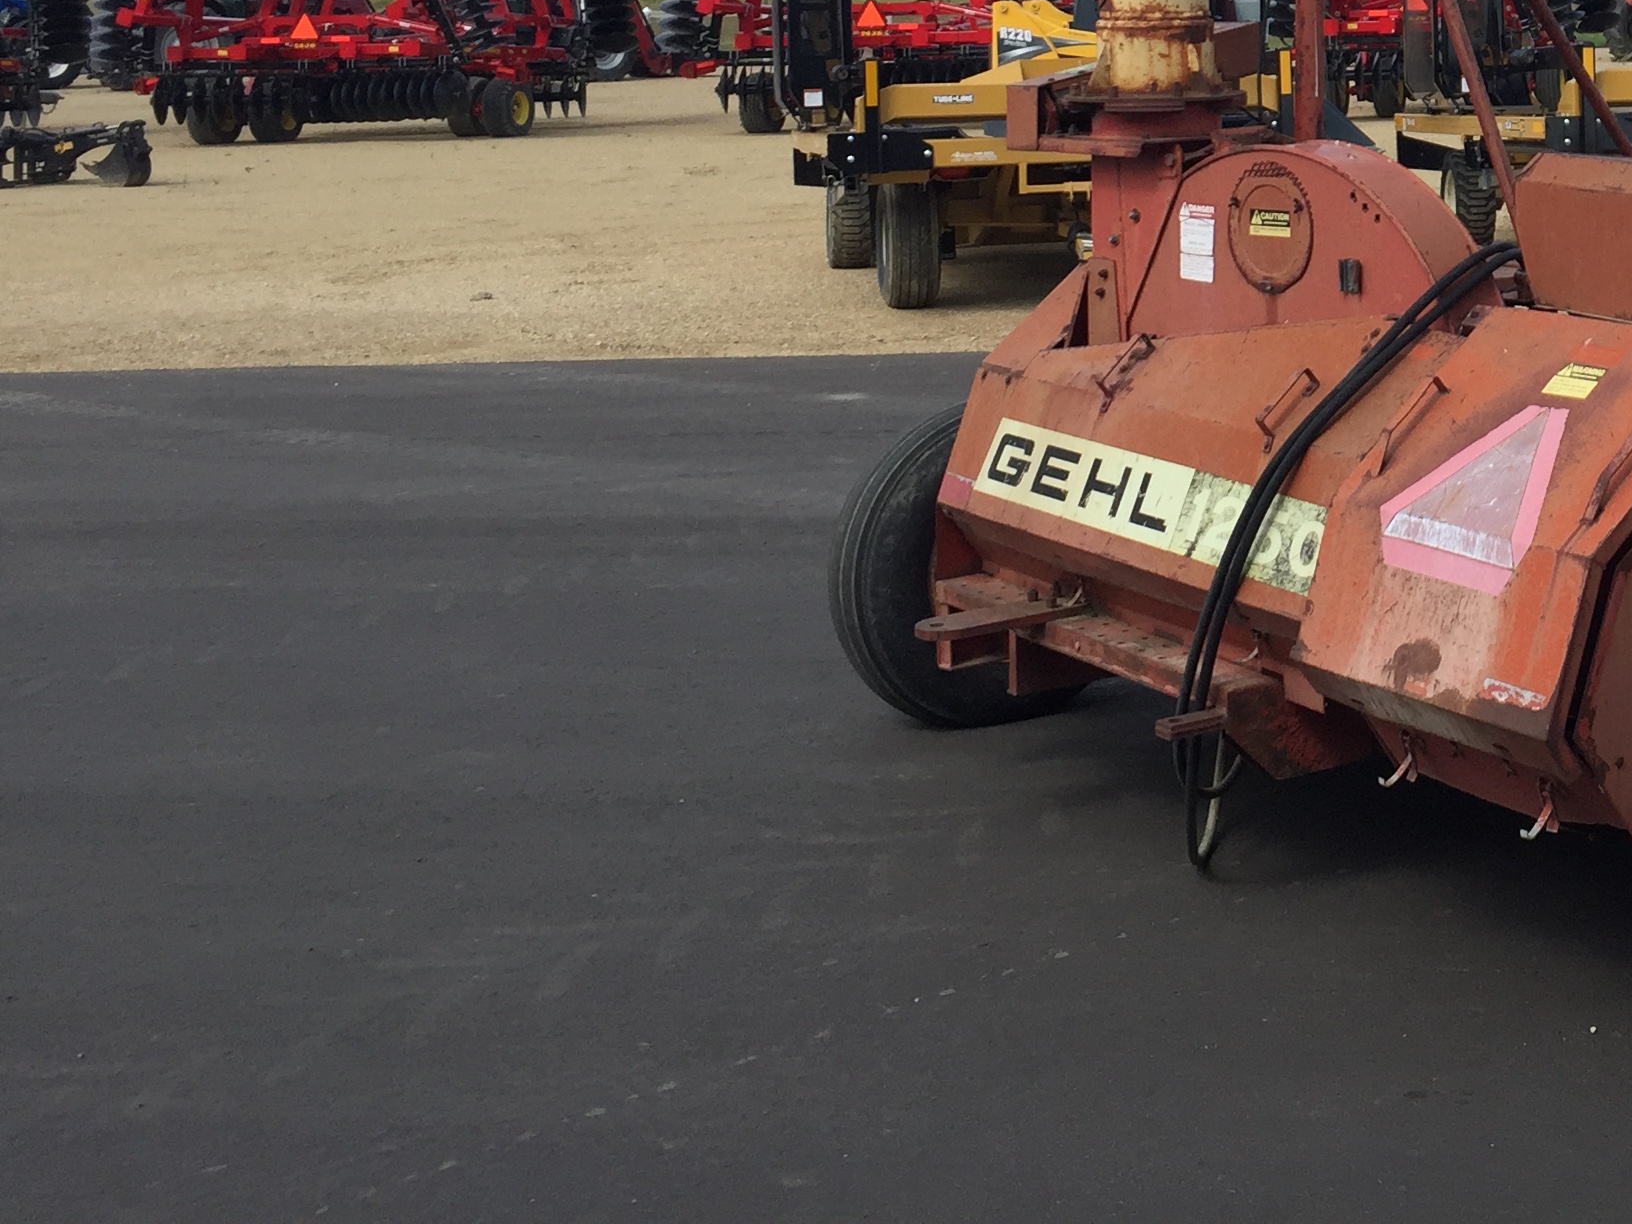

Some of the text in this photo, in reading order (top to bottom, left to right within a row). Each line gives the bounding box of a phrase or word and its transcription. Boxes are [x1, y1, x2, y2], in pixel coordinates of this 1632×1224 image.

[1000, 26, 1032, 43] R220
[1260, 211, 1290, 221] CAUTION
[987, 432, 1167, 534] GEHL
